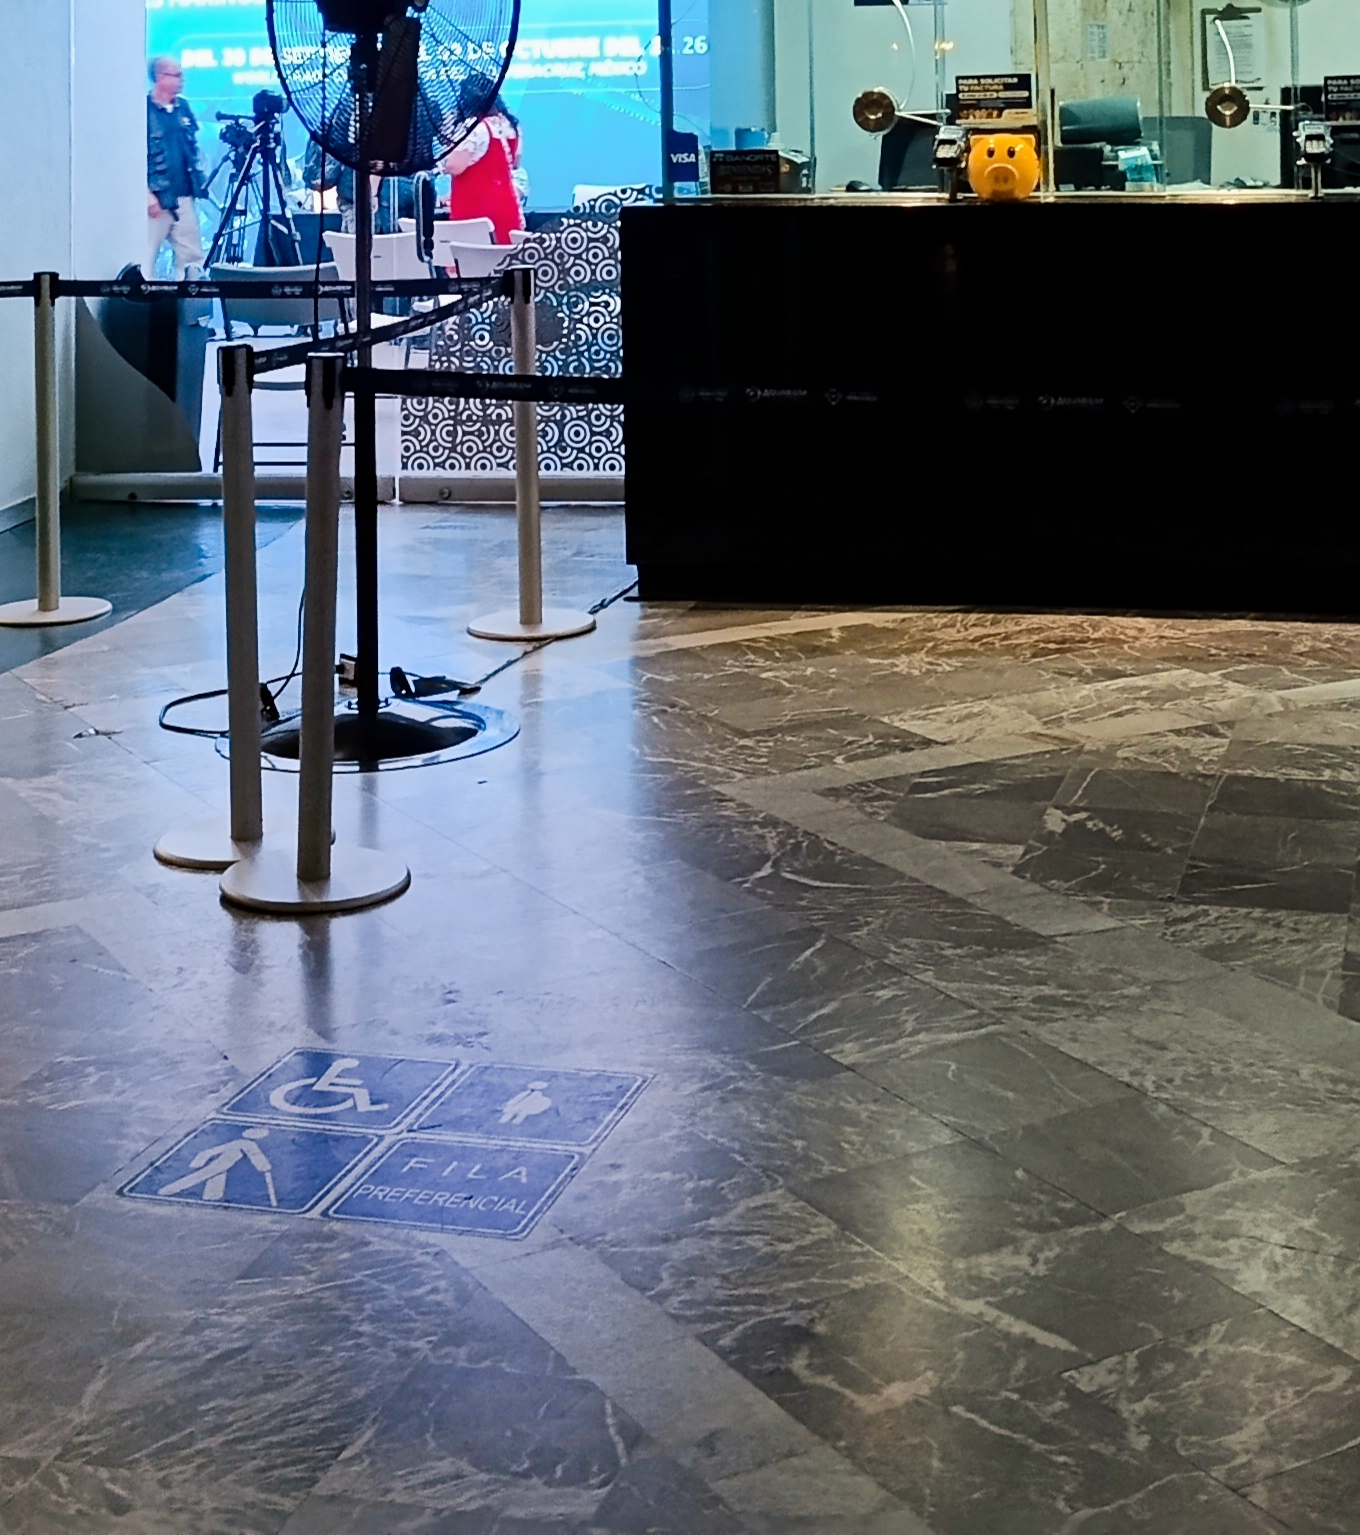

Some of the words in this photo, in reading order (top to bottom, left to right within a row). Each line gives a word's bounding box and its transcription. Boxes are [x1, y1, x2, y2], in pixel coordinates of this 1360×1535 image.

[670, 153, 696, 163] VISA
[726, 153, 777, 162] BANORTE
[401, 1157, 528, 1183] FILA
[353, 1184, 528, 1214] PREFERENCIAL
